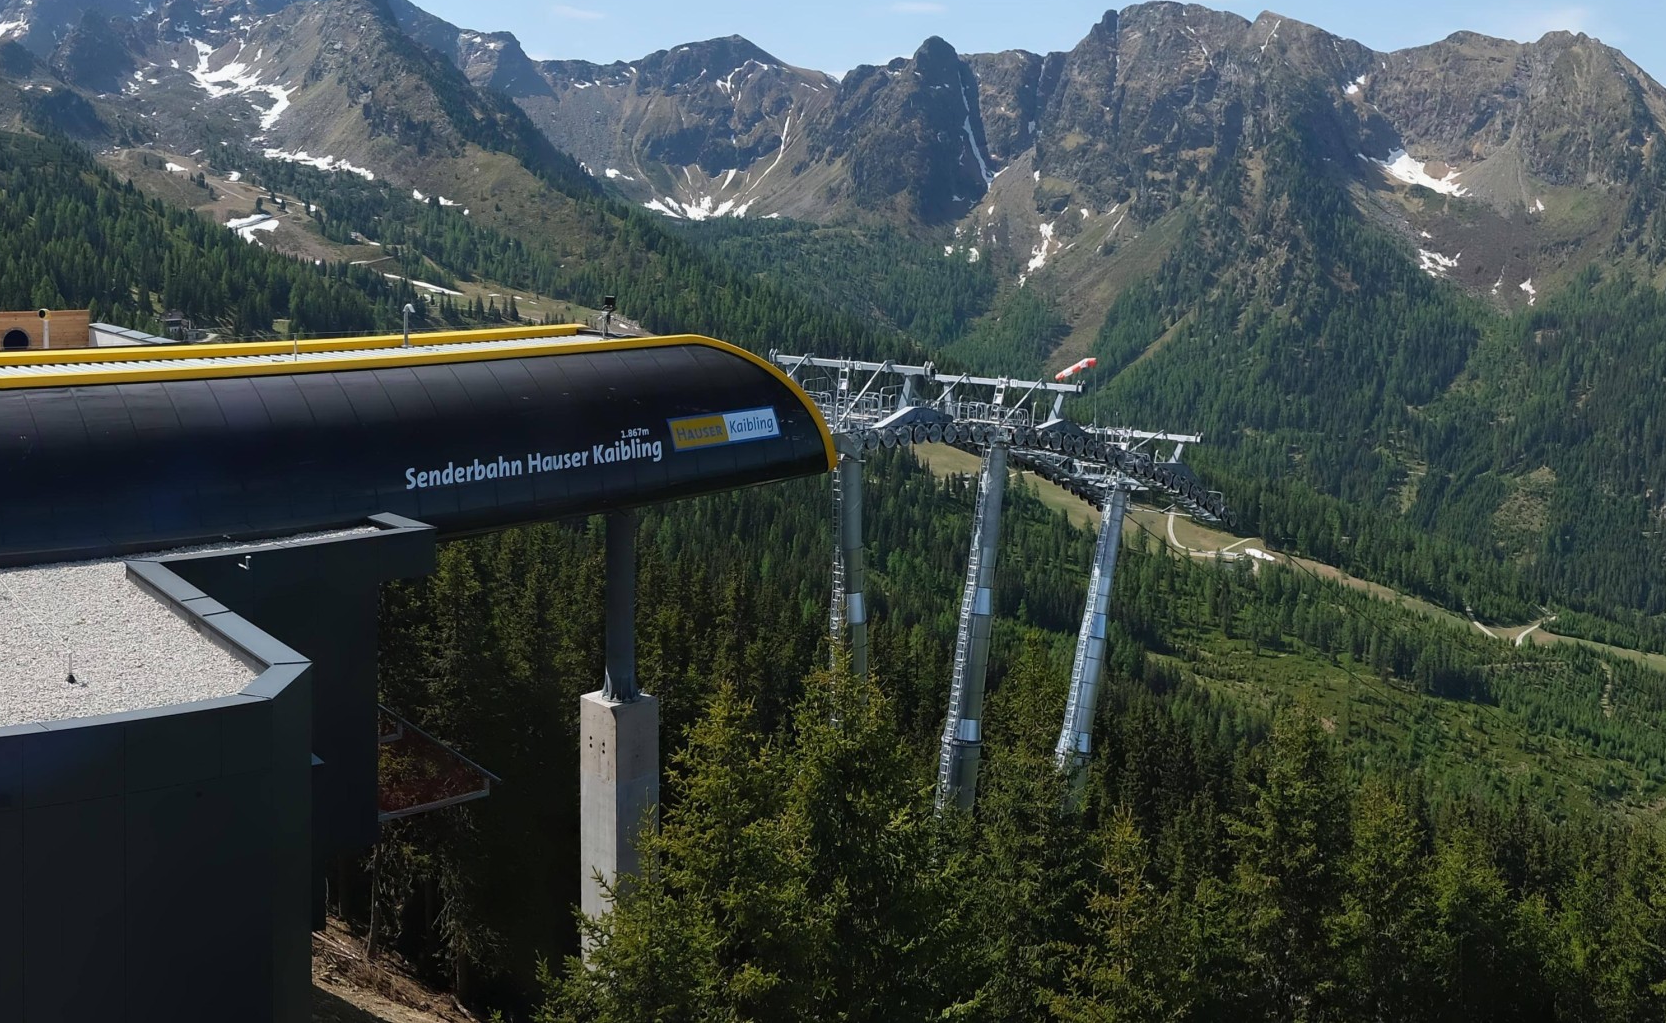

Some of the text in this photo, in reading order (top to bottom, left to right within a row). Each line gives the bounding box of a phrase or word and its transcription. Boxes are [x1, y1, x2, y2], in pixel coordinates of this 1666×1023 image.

[620, 427, 650, 439] 1.867m
[676, 414, 774, 442] HAUSER Kaibling
[405, 438, 663, 490] Senderbahn Hauser Kaibling
